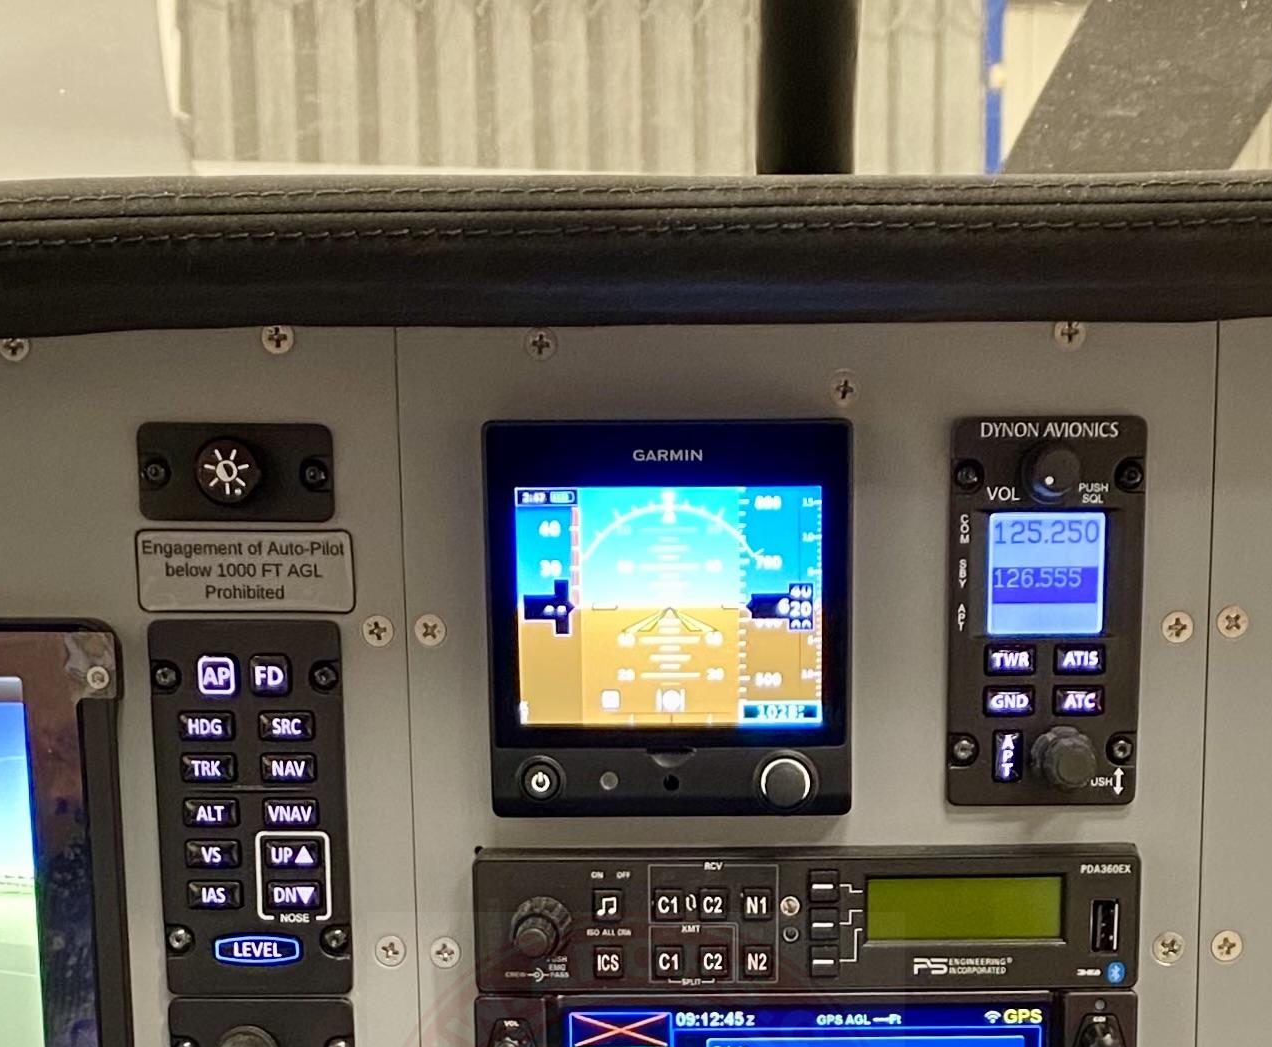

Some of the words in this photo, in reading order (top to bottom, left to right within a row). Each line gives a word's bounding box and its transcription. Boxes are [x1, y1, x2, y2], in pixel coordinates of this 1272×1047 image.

[981, 422, 1039, 438] DYNON
[1044, 422, 1119, 437] AVIONICS
[633, 449, 703, 462] GARMIN
[987, 486, 1020, 500] VOL
[1079, 483, 1108, 493] PUSH
[994, 520, 1099, 544] 125.250
[142, 541, 242, 557] Engagement
[248, 541, 262, 555] of
[267, 541, 344, 556] Auto-Pilot
[165, 562, 211, 577] below
[218, 563, 256, 577] 1000
[262, 564, 282, 577] FT
[288, 564, 323, 578] AGL
[993, 568, 1082, 588] 126.555
[206, 585, 284, 599] Prohibited
[992, 651, 1030, 667] TWR
[1063, 650, 1098, 666] ATIS
[203, 667, 231, 686] AP
[254, 667, 284, 686] FD
[991, 694, 1029, 709] GND
[1064, 693, 1095, 708] ATC
[187, 719, 222, 734] HDG
[272, 718, 302, 734] SRC
[191, 761, 221, 777] TRK
[272, 761, 305, 777] NAV
[196, 805, 224, 821] ALT
[268, 805, 312, 821] VNAV
[201, 847, 222, 863] VS
[271, 847, 293, 863] UP
[201, 887, 225, 903] IAS
[273, 887, 296, 903] DN
[658, 896, 678, 914] C1
[703, 896, 723, 914] C2
[746, 896, 767, 914] N1
[280, 913, 309, 923] NOSE
[233, 942, 282, 957] LEVEL
[597, 954, 619, 971] ICS
[659, 954, 679, 970] C1
[703, 954, 723, 970] C2
[747, 954, 768, 970] N2
[1004, 1009, 1042, 1023] GPS
